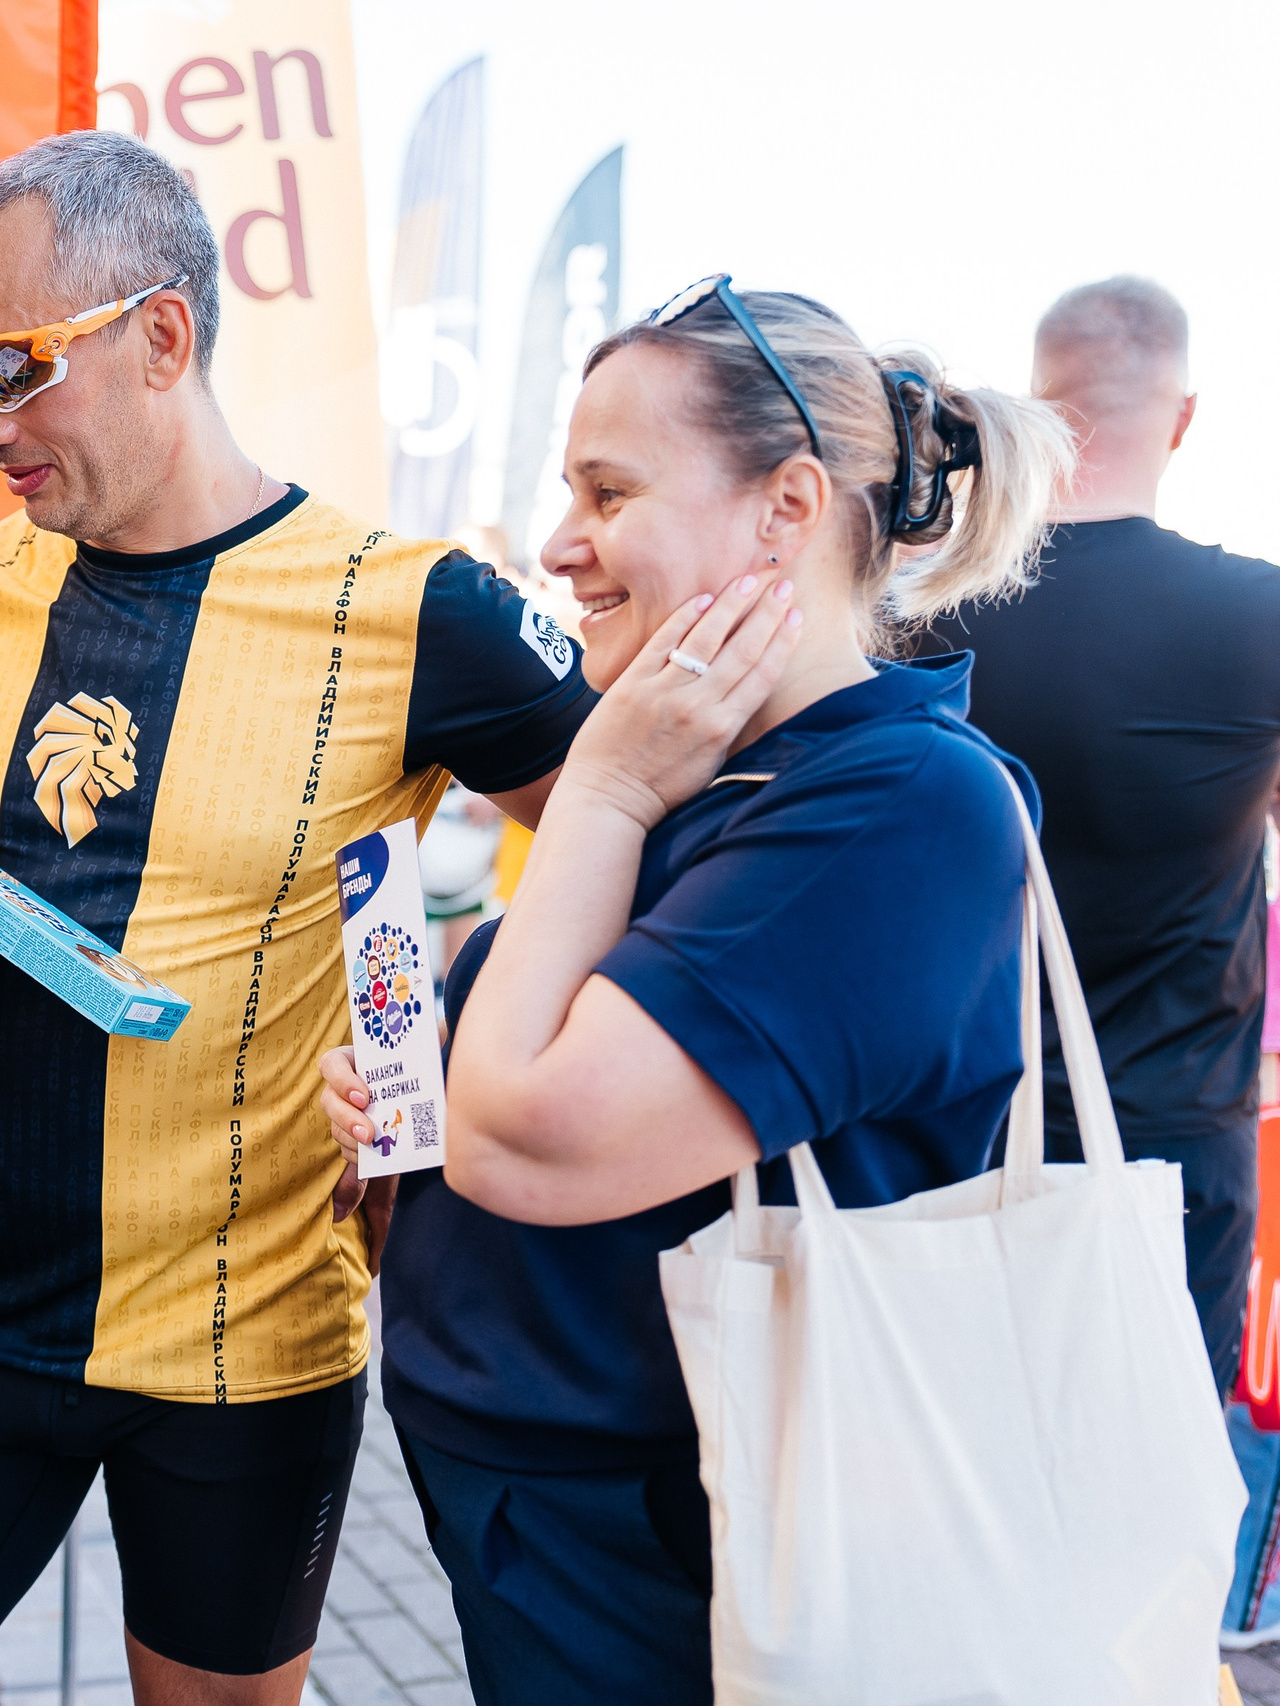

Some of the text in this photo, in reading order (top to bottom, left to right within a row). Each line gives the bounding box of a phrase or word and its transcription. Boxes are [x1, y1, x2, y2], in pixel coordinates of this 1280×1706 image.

[301, 646, 343, 805] ВЛАДИМИРСКИЙ
[260, 818, 309, 945] ПОЛУМАРАОН
[339, 857, 361, 880] НАШИ
[341, 872, 373, 899] БРЕНДЫ
[232, 950, 265, 1106] ВЛАДИМИРСКИЙ
[365, 1061, 404, 1085] ВАКАНСИИ
[368, 1077, 421, 1105] НА ФАБРИКАХ
[216, 1119, 243, 1247] ПОЛУМАРАОН
